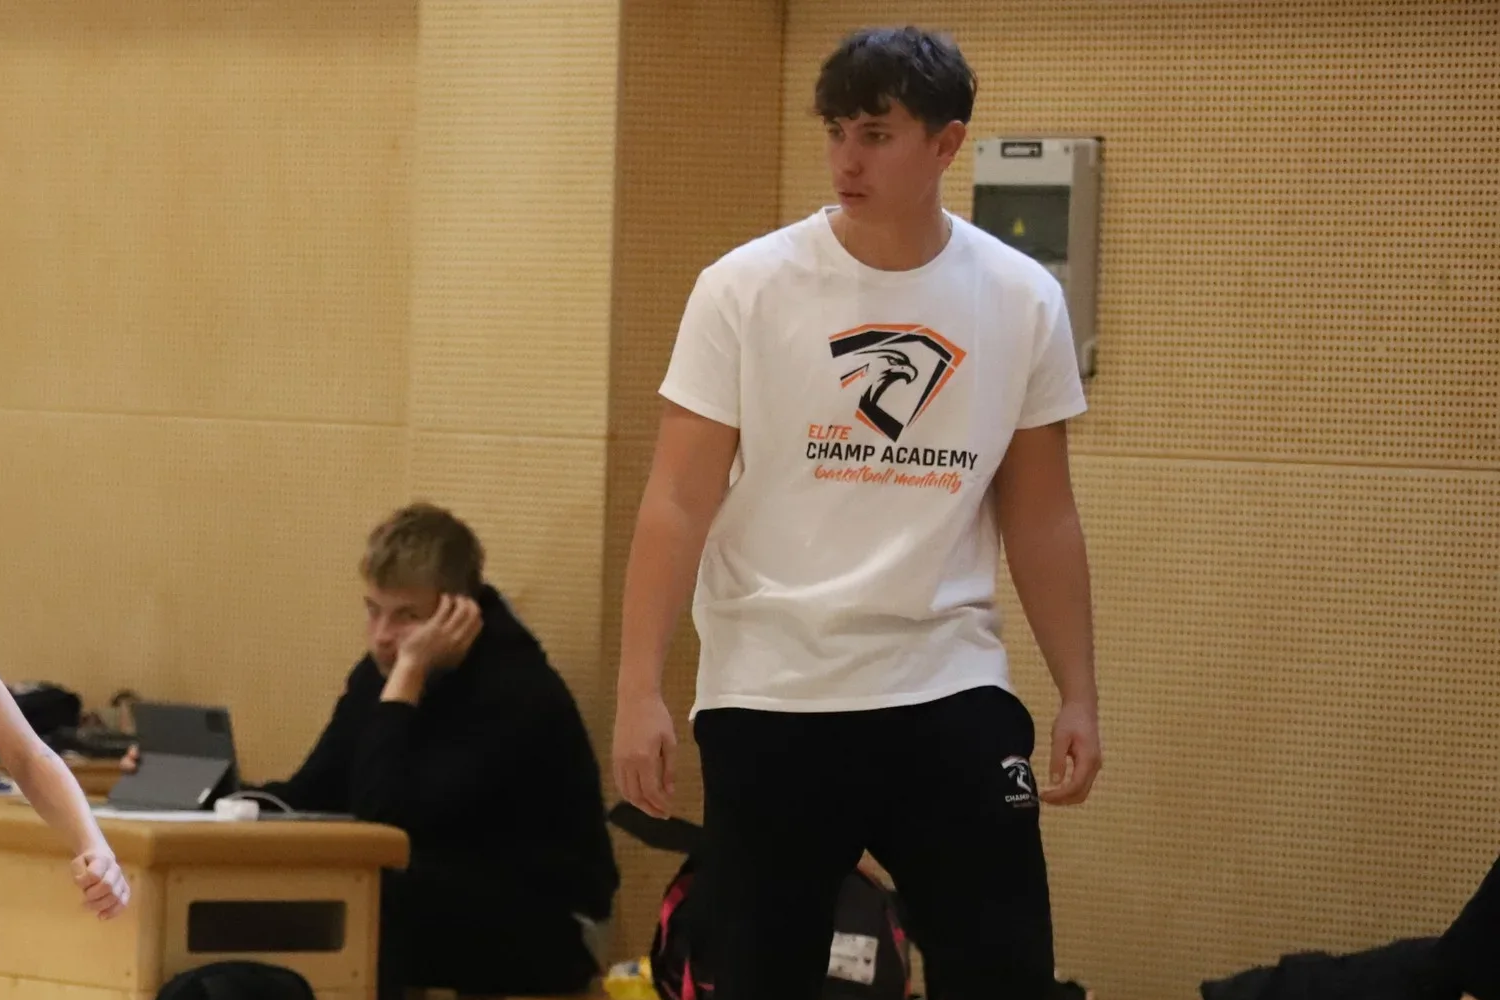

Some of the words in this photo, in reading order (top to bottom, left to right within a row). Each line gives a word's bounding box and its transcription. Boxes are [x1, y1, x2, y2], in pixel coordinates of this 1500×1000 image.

[806, 442, 876, 463] CHAMP
[880, 446, 978, 471] ACADEMY
[814, 464, 894, 484] basketball
[894, 470, 962, 495] mentality
